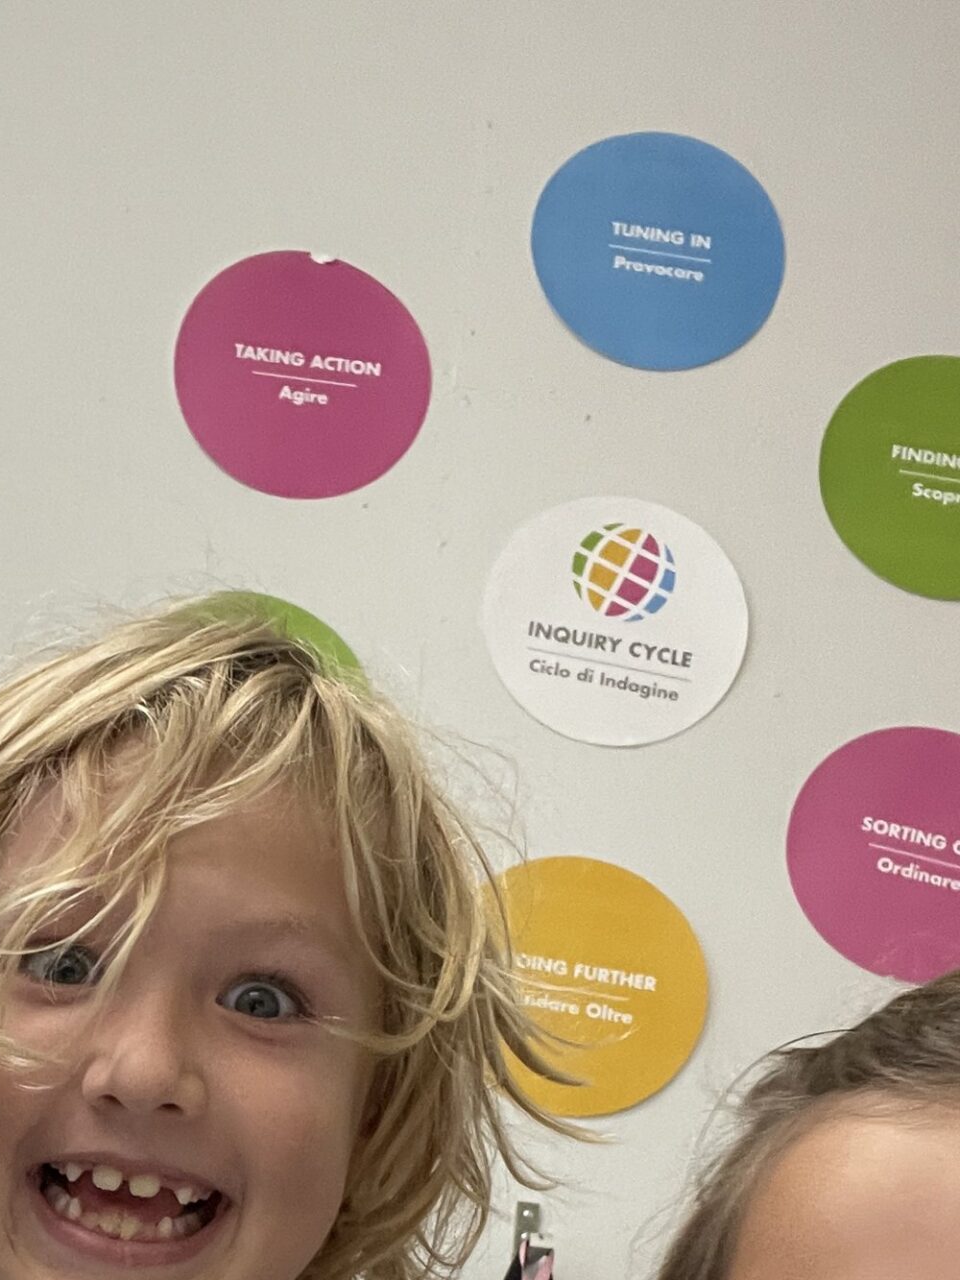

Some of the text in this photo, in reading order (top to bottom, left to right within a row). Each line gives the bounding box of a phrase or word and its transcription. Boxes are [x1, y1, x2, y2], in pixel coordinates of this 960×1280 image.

[611, 221, 712, 250] TUNING IN
[613, 255, 704, 282] Provocare
[234, 343, 382, 377] TAKING ACTION
[278, 385, 329, 406] Agire
[527, 620, 694, 669] INQUIRY CYCLE
[529, 658, 680, 702] Ciclo di Indagine
[861, 816, 948, 851] SORTING
[877, 856, 960, 891] Ordinare
[573, 963, 657, 992] FURTHER
[585, 1002, 634, 1025] Oltre
